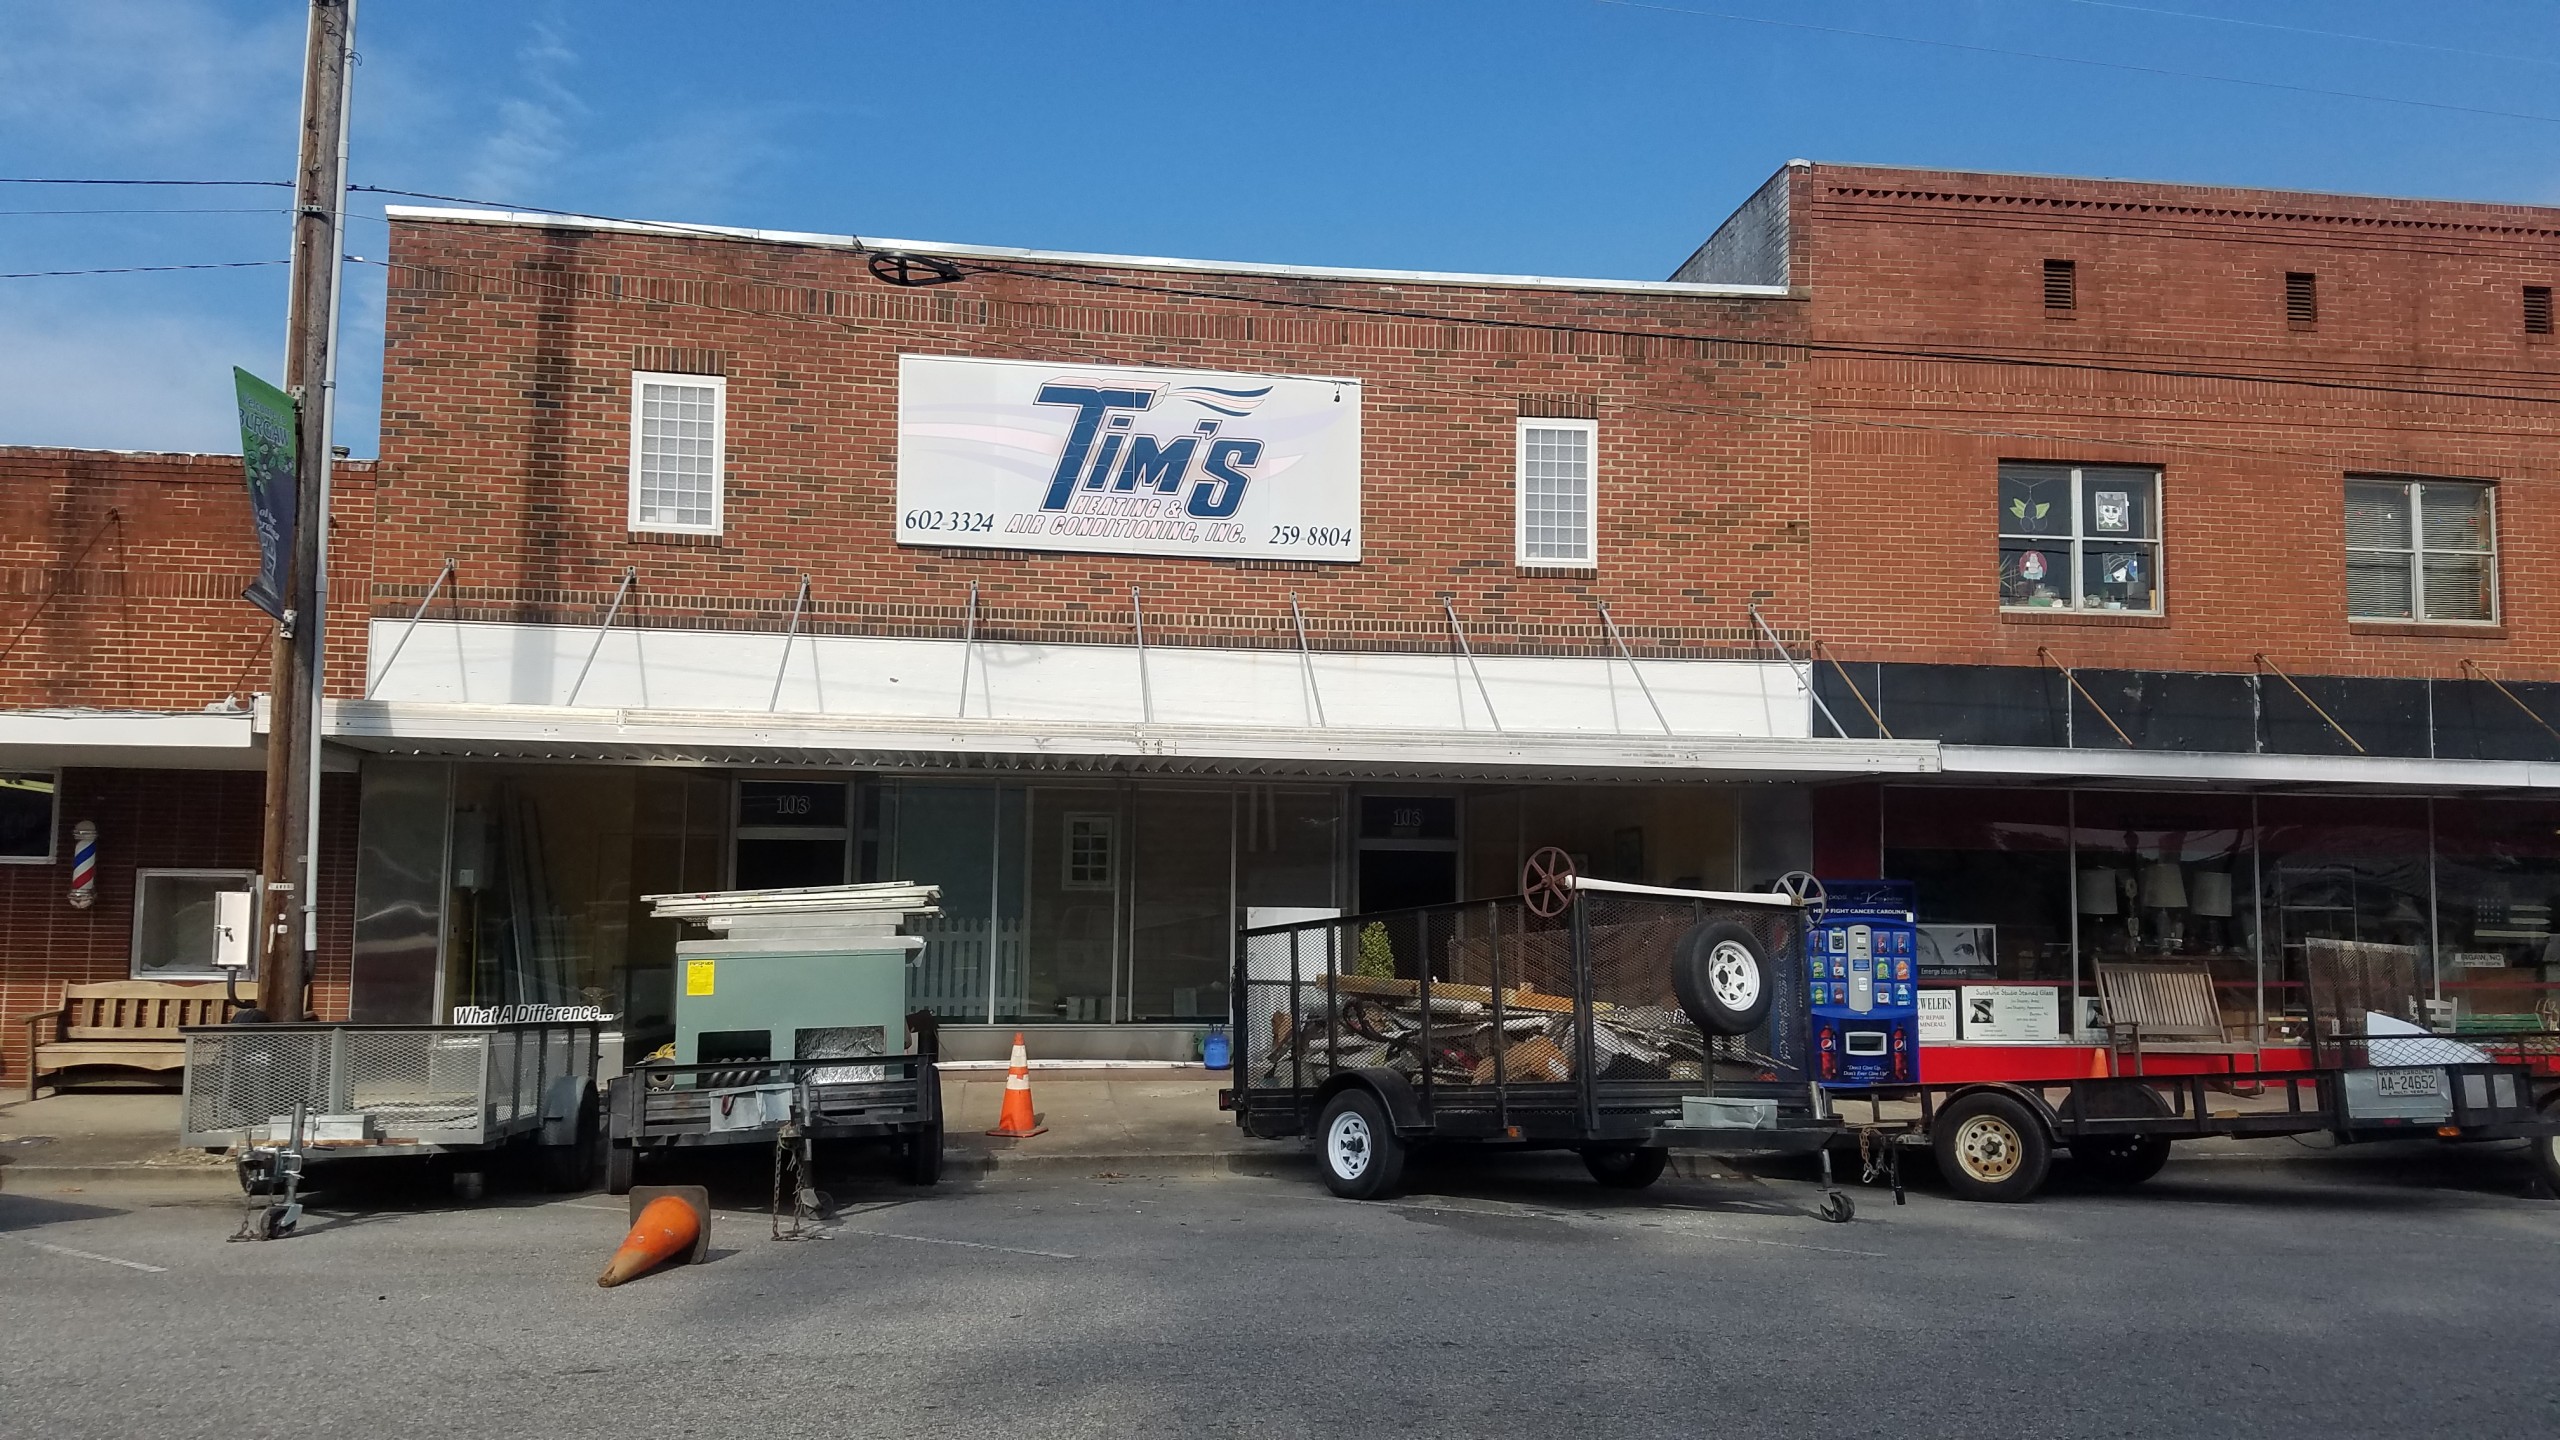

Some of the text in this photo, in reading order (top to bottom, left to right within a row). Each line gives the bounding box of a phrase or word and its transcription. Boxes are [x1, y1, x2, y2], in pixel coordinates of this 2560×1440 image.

[1072, 496, 1182, 518] HEATING &
[905, 509, 995, 533] 602-3324
[1005, 513, 1247, 543] AIR CONDITIONING, INC.
[1268, 525, 1352, 547] 259-8804
[777, 794, 811, 815] 103
[1921, 968, 1940, 977] Emerge
[1941, 968, 1957, 976] Studio
[455, 1006, 498, 1024] What
[500, 1006, 514, 1023] A
[2381, 1075, 2436, 1090] AA-24652
